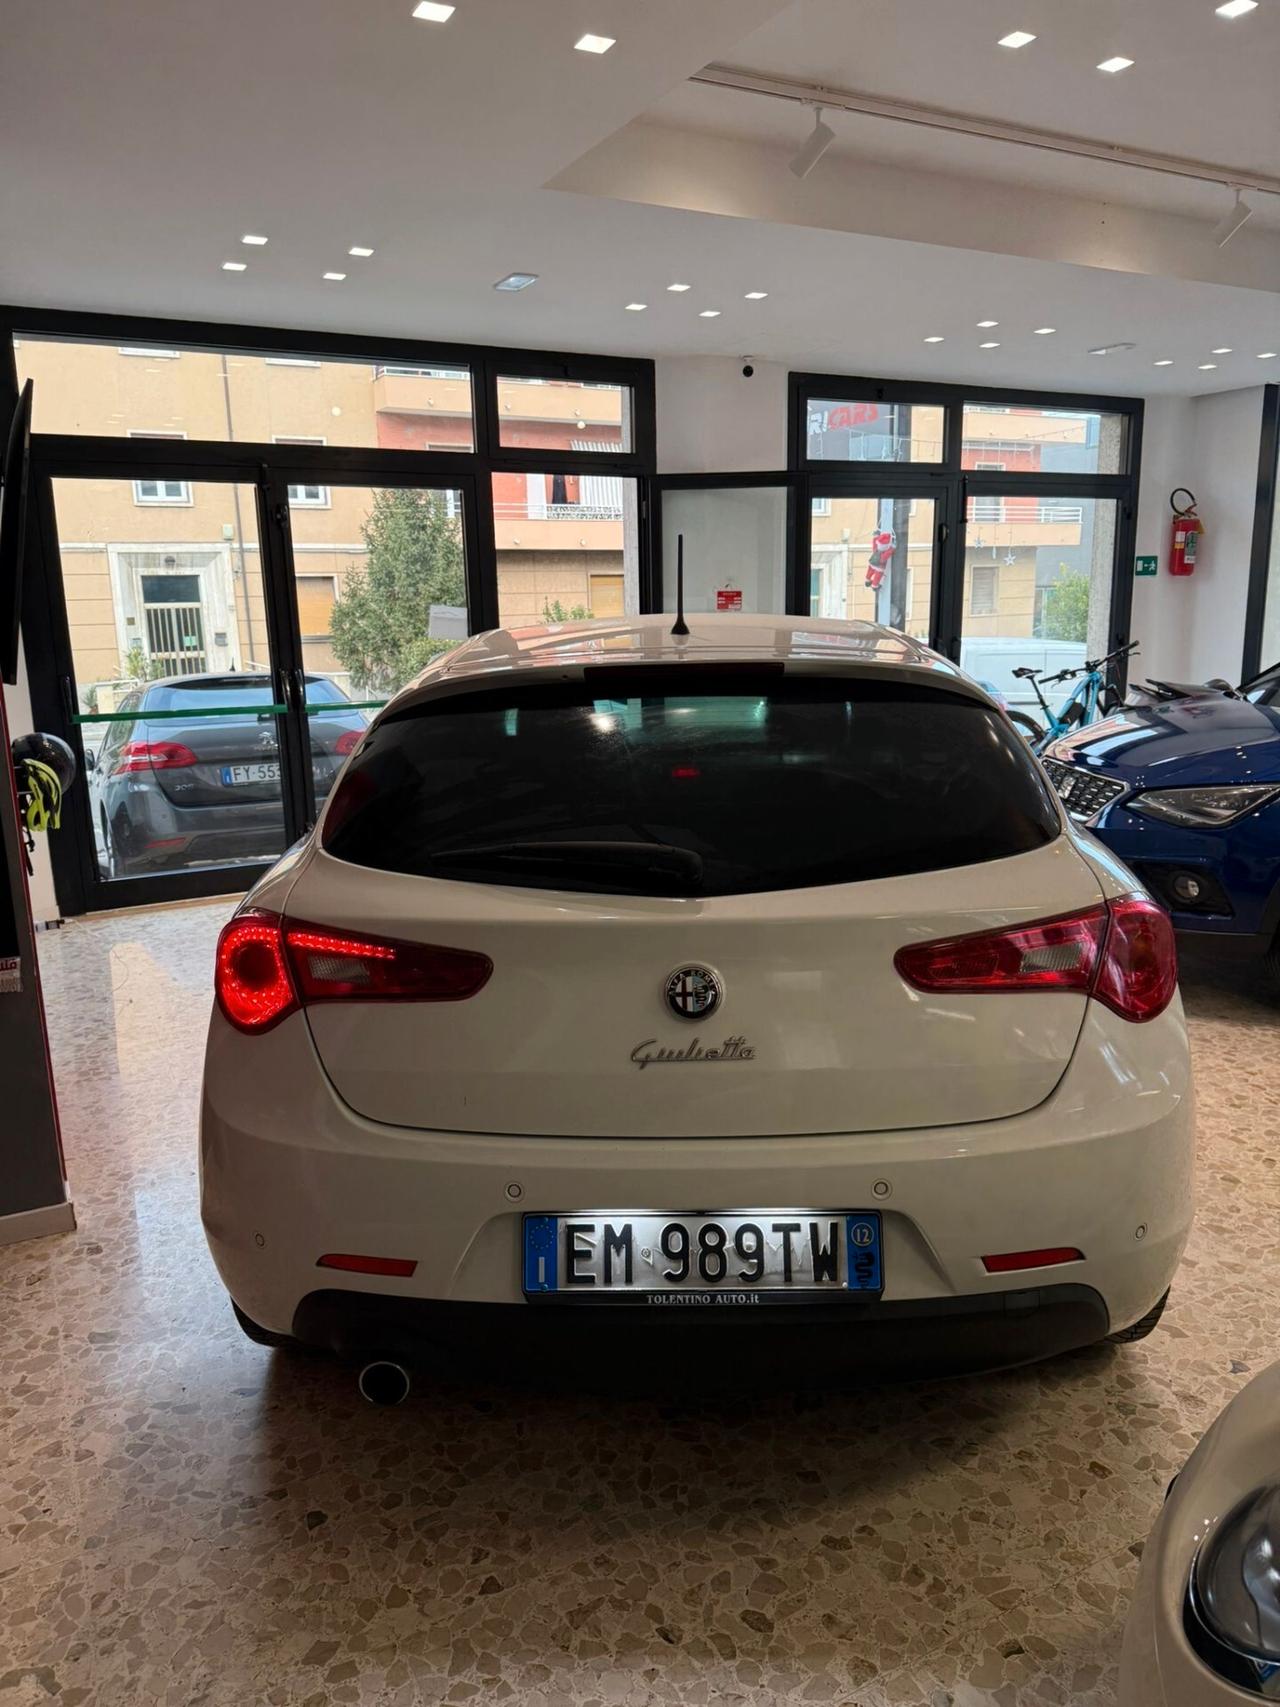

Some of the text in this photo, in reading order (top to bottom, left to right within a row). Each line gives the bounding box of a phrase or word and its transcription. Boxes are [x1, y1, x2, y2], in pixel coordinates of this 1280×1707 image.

[232, 766, 251, 781] FY
[630, 1035, 757, 1070] Giulietta
[854, 1229, 870, 1243] 12
[566, 1222, 839, 1284] EM 989TW
[646, 1293, 760, 1304] TOLENTINO AUTO.it
